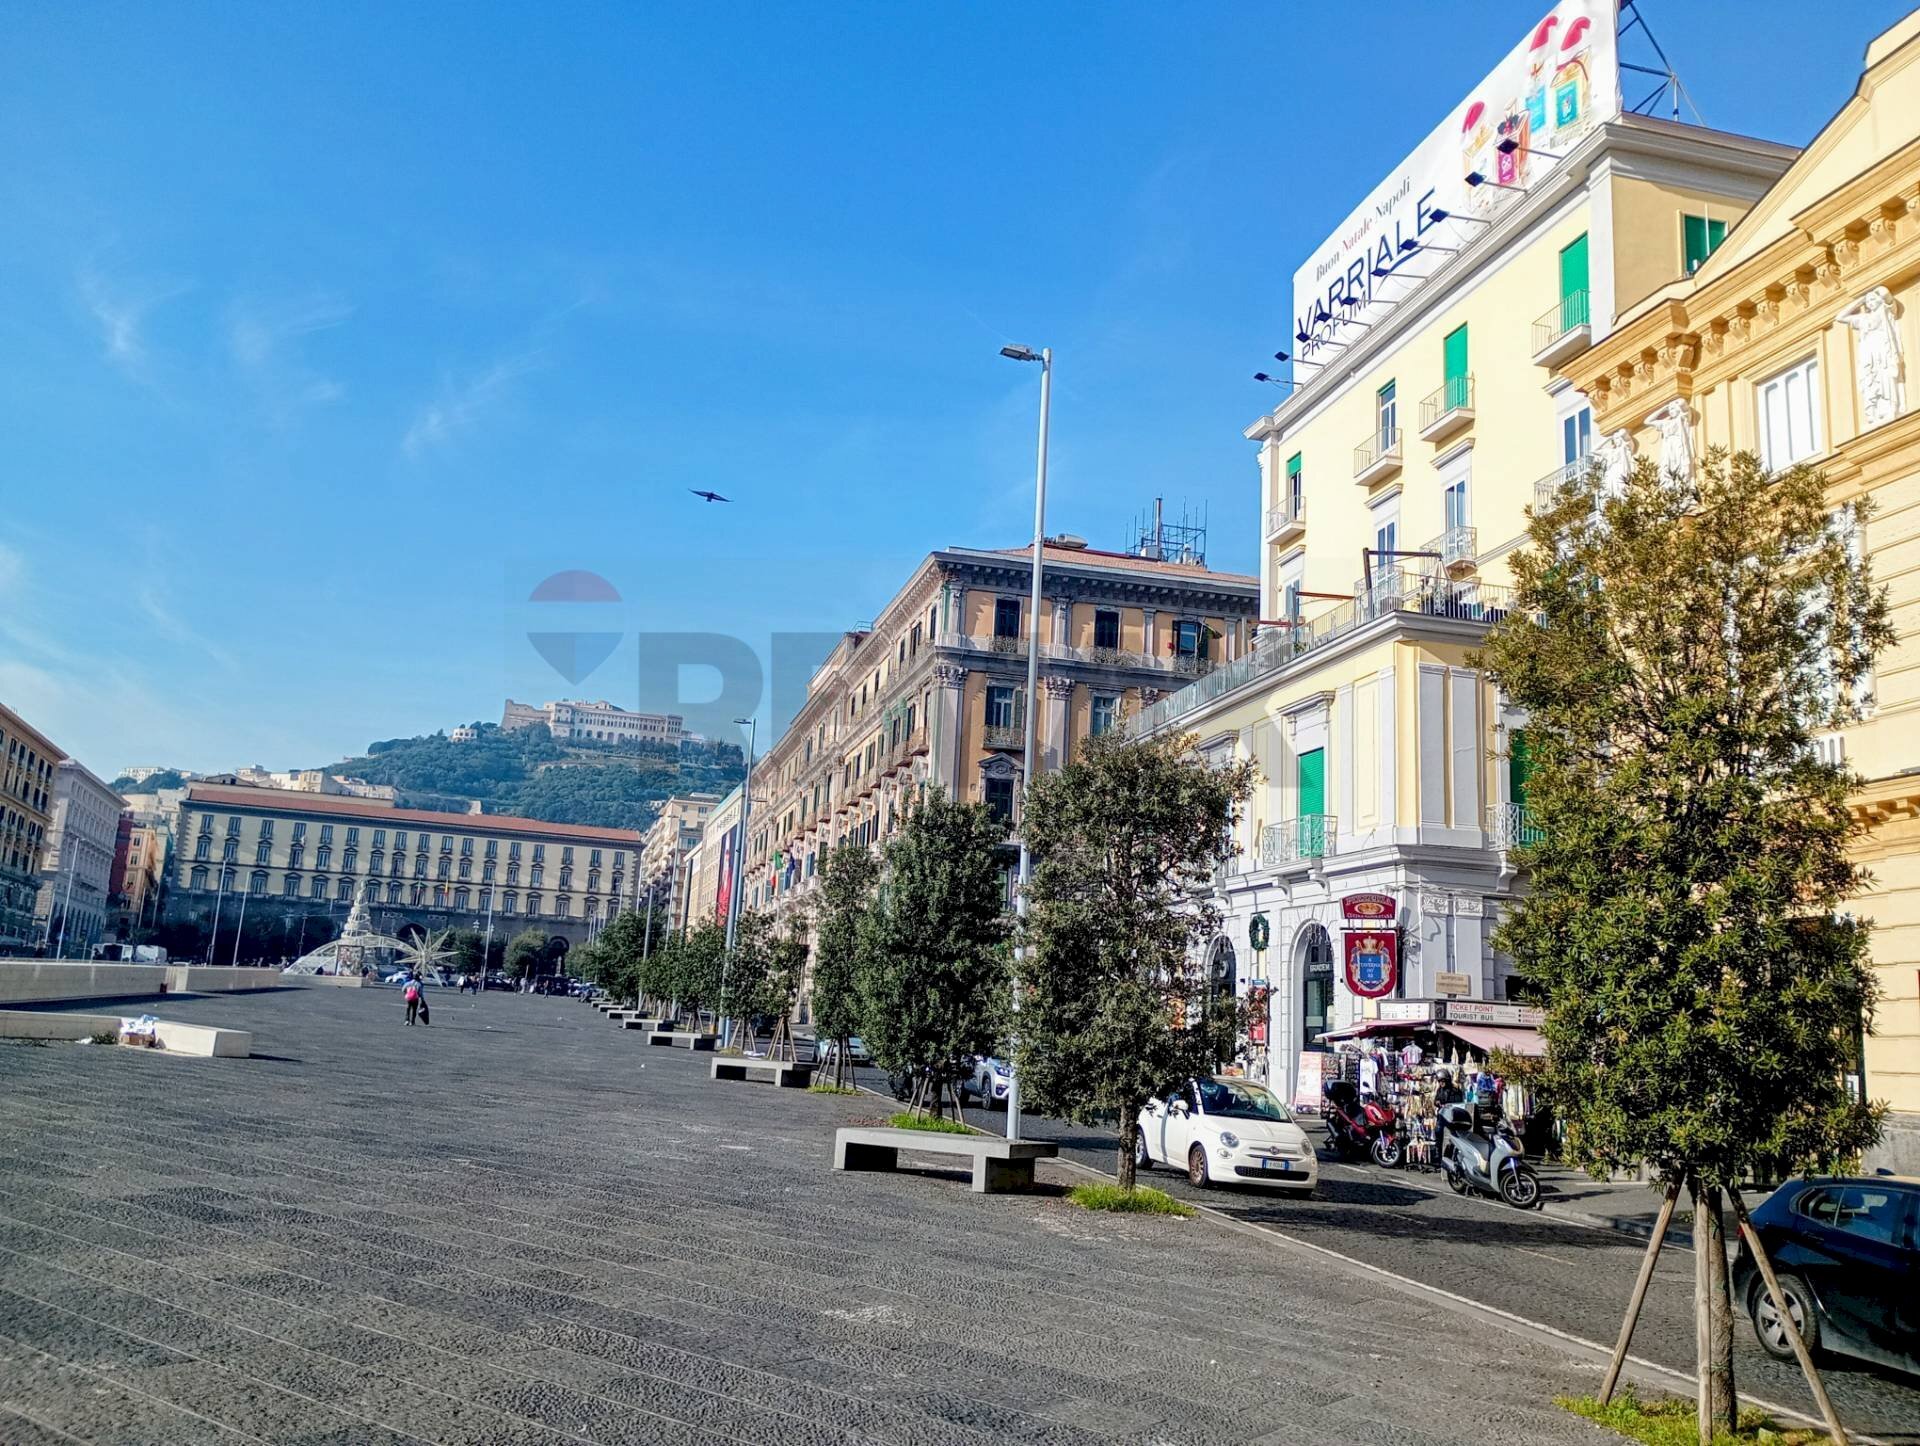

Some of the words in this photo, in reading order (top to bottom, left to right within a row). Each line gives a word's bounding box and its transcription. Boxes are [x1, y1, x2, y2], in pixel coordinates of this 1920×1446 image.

[1298, 186, 1435, 336] VARRIALE
[1316, 252, 1340, 282] Buon
[1342, 217, 1373, 254] Natale
[1375, 176, 1411, 222] Napoli
[1450, 1003, 1472, 1011] TICKET
[1474, 1004, 1494, 1012] POINT
